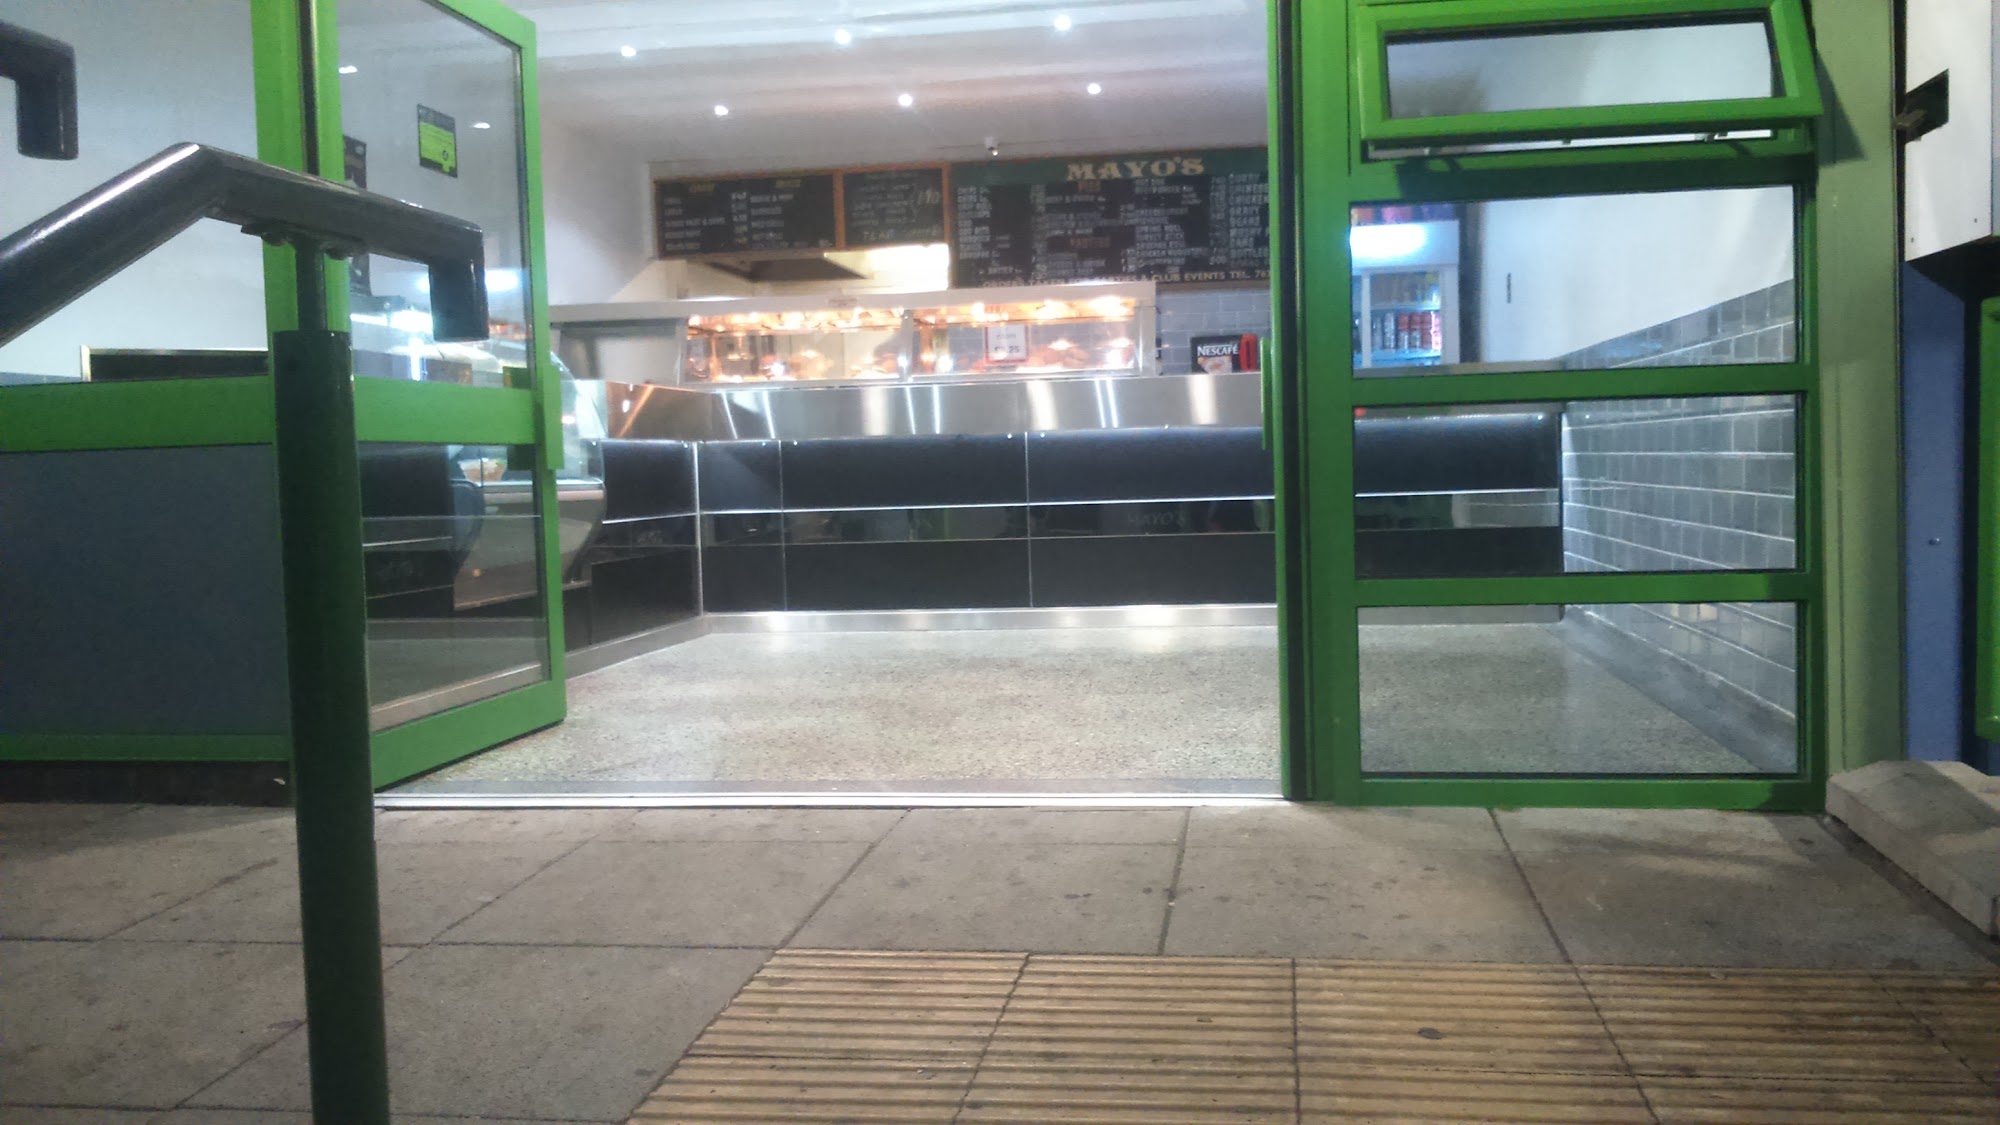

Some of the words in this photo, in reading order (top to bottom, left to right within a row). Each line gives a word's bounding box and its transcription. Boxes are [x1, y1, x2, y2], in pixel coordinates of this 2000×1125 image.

[1066, 157, 1205, 180] MAYO'S
[1152, 273, 1180, 282] CLUB
[1183, 271, 1225, 281] EVENTS
[1197, 344, 1239, 356] NESCAFÉ
